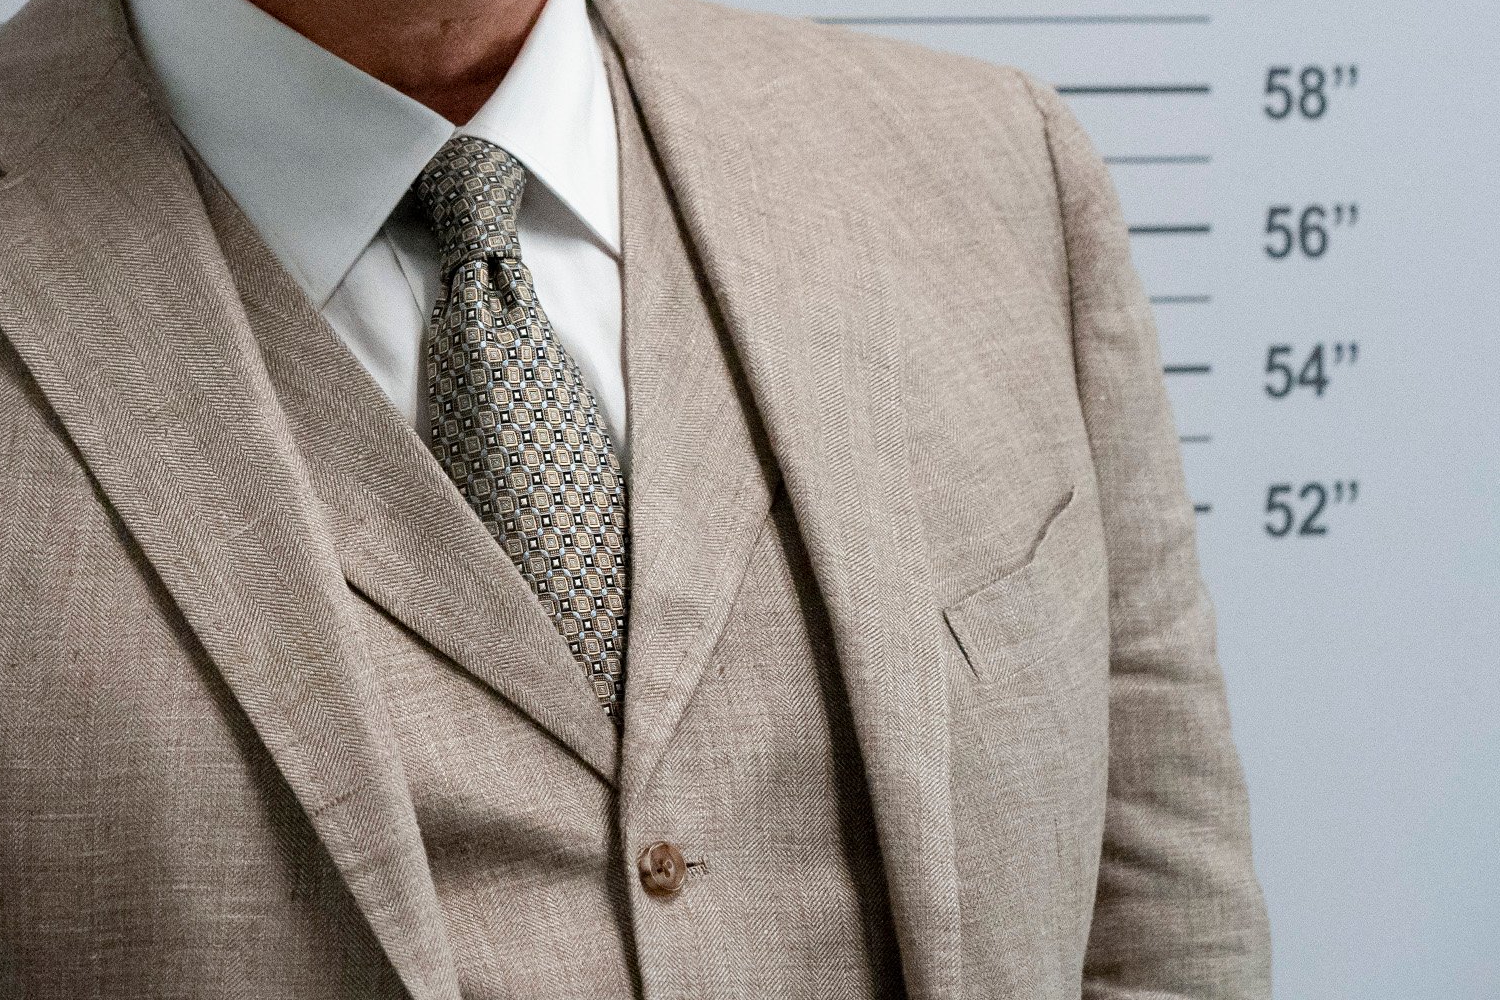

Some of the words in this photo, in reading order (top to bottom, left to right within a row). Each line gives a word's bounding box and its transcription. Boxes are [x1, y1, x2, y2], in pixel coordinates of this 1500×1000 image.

[1262, 63, 1359, 123] 58”
[1262, 202, 1359, 262] 56”
[1263, 340, 1360, 401] 54”
[1262, 479, 1360, 540] 52”
